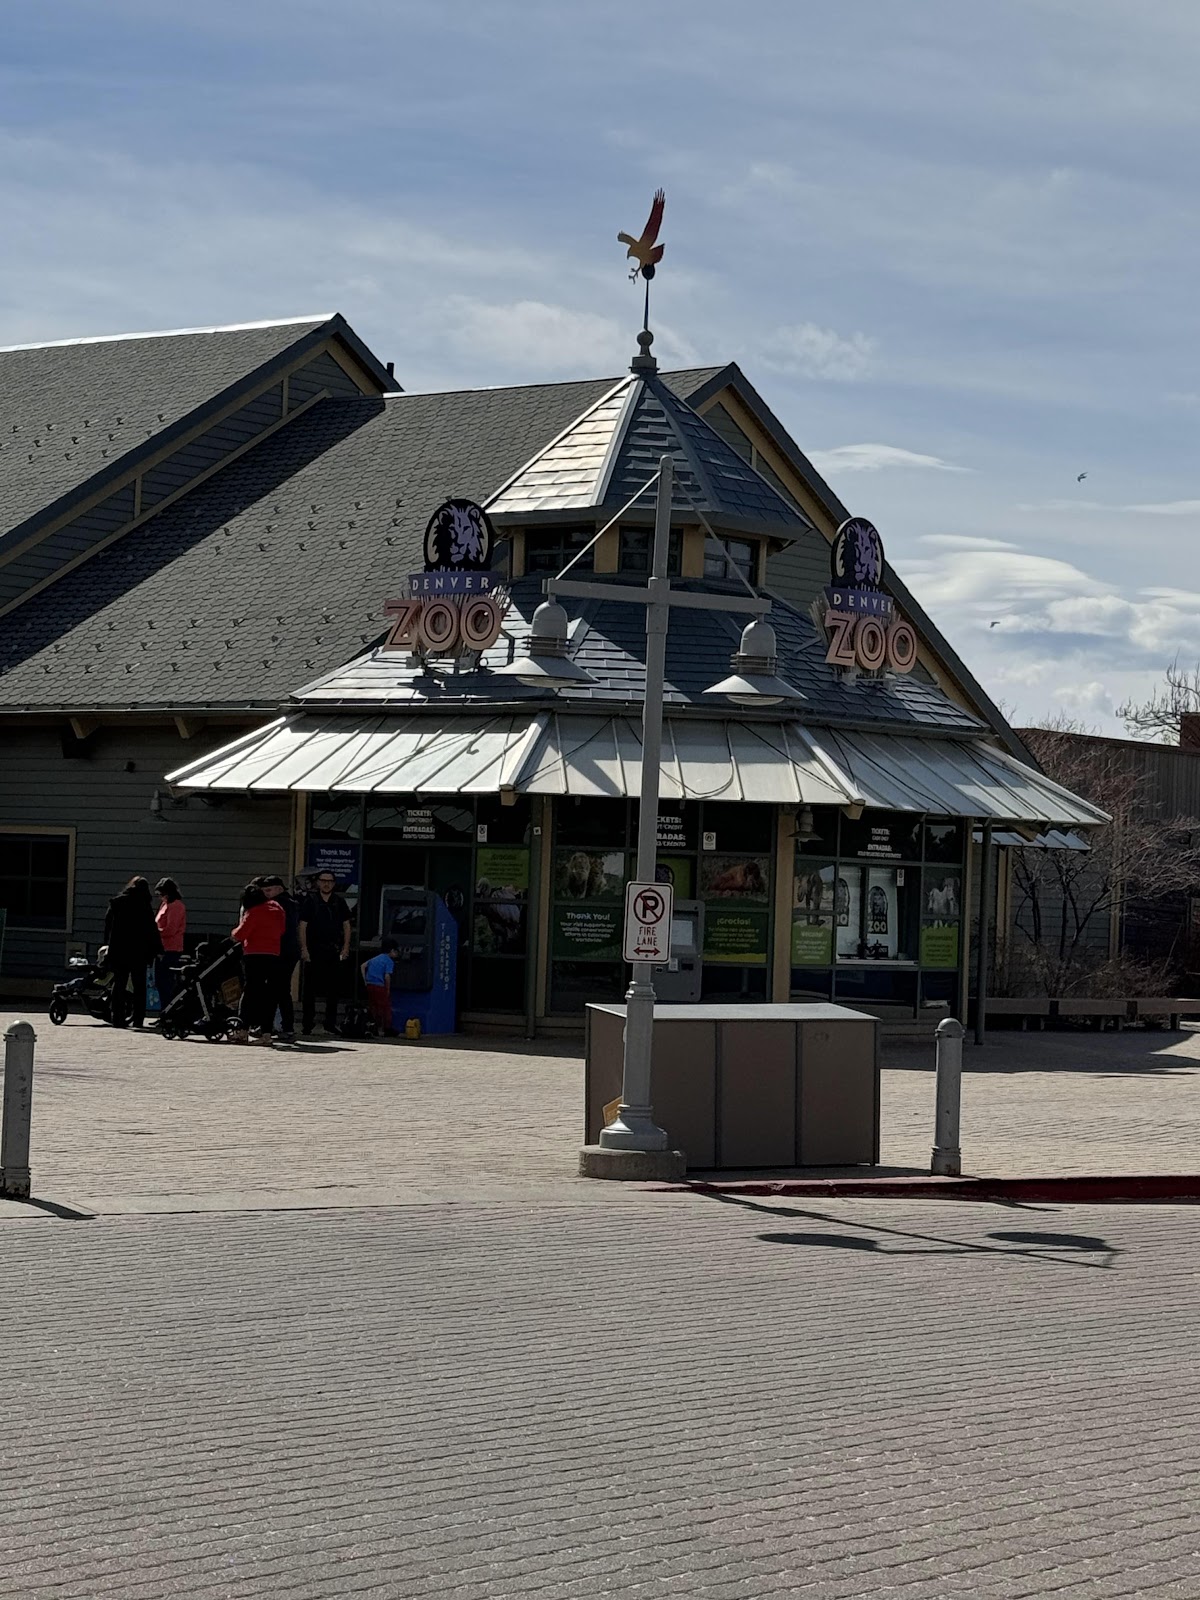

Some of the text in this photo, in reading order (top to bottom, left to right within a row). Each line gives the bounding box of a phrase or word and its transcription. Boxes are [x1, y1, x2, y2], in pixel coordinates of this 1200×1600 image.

[412, 577, 490, 591] DENVER
[382, 597, 502, 652] ZOO
[824, 609, 917, 673] ZOO
[656, 816, 682, 824] CKETS:
[638, 926, 657, 937] FIRE
[868, 920, 887, 933] ZOO
[636, 936, 658, 947] LANE
